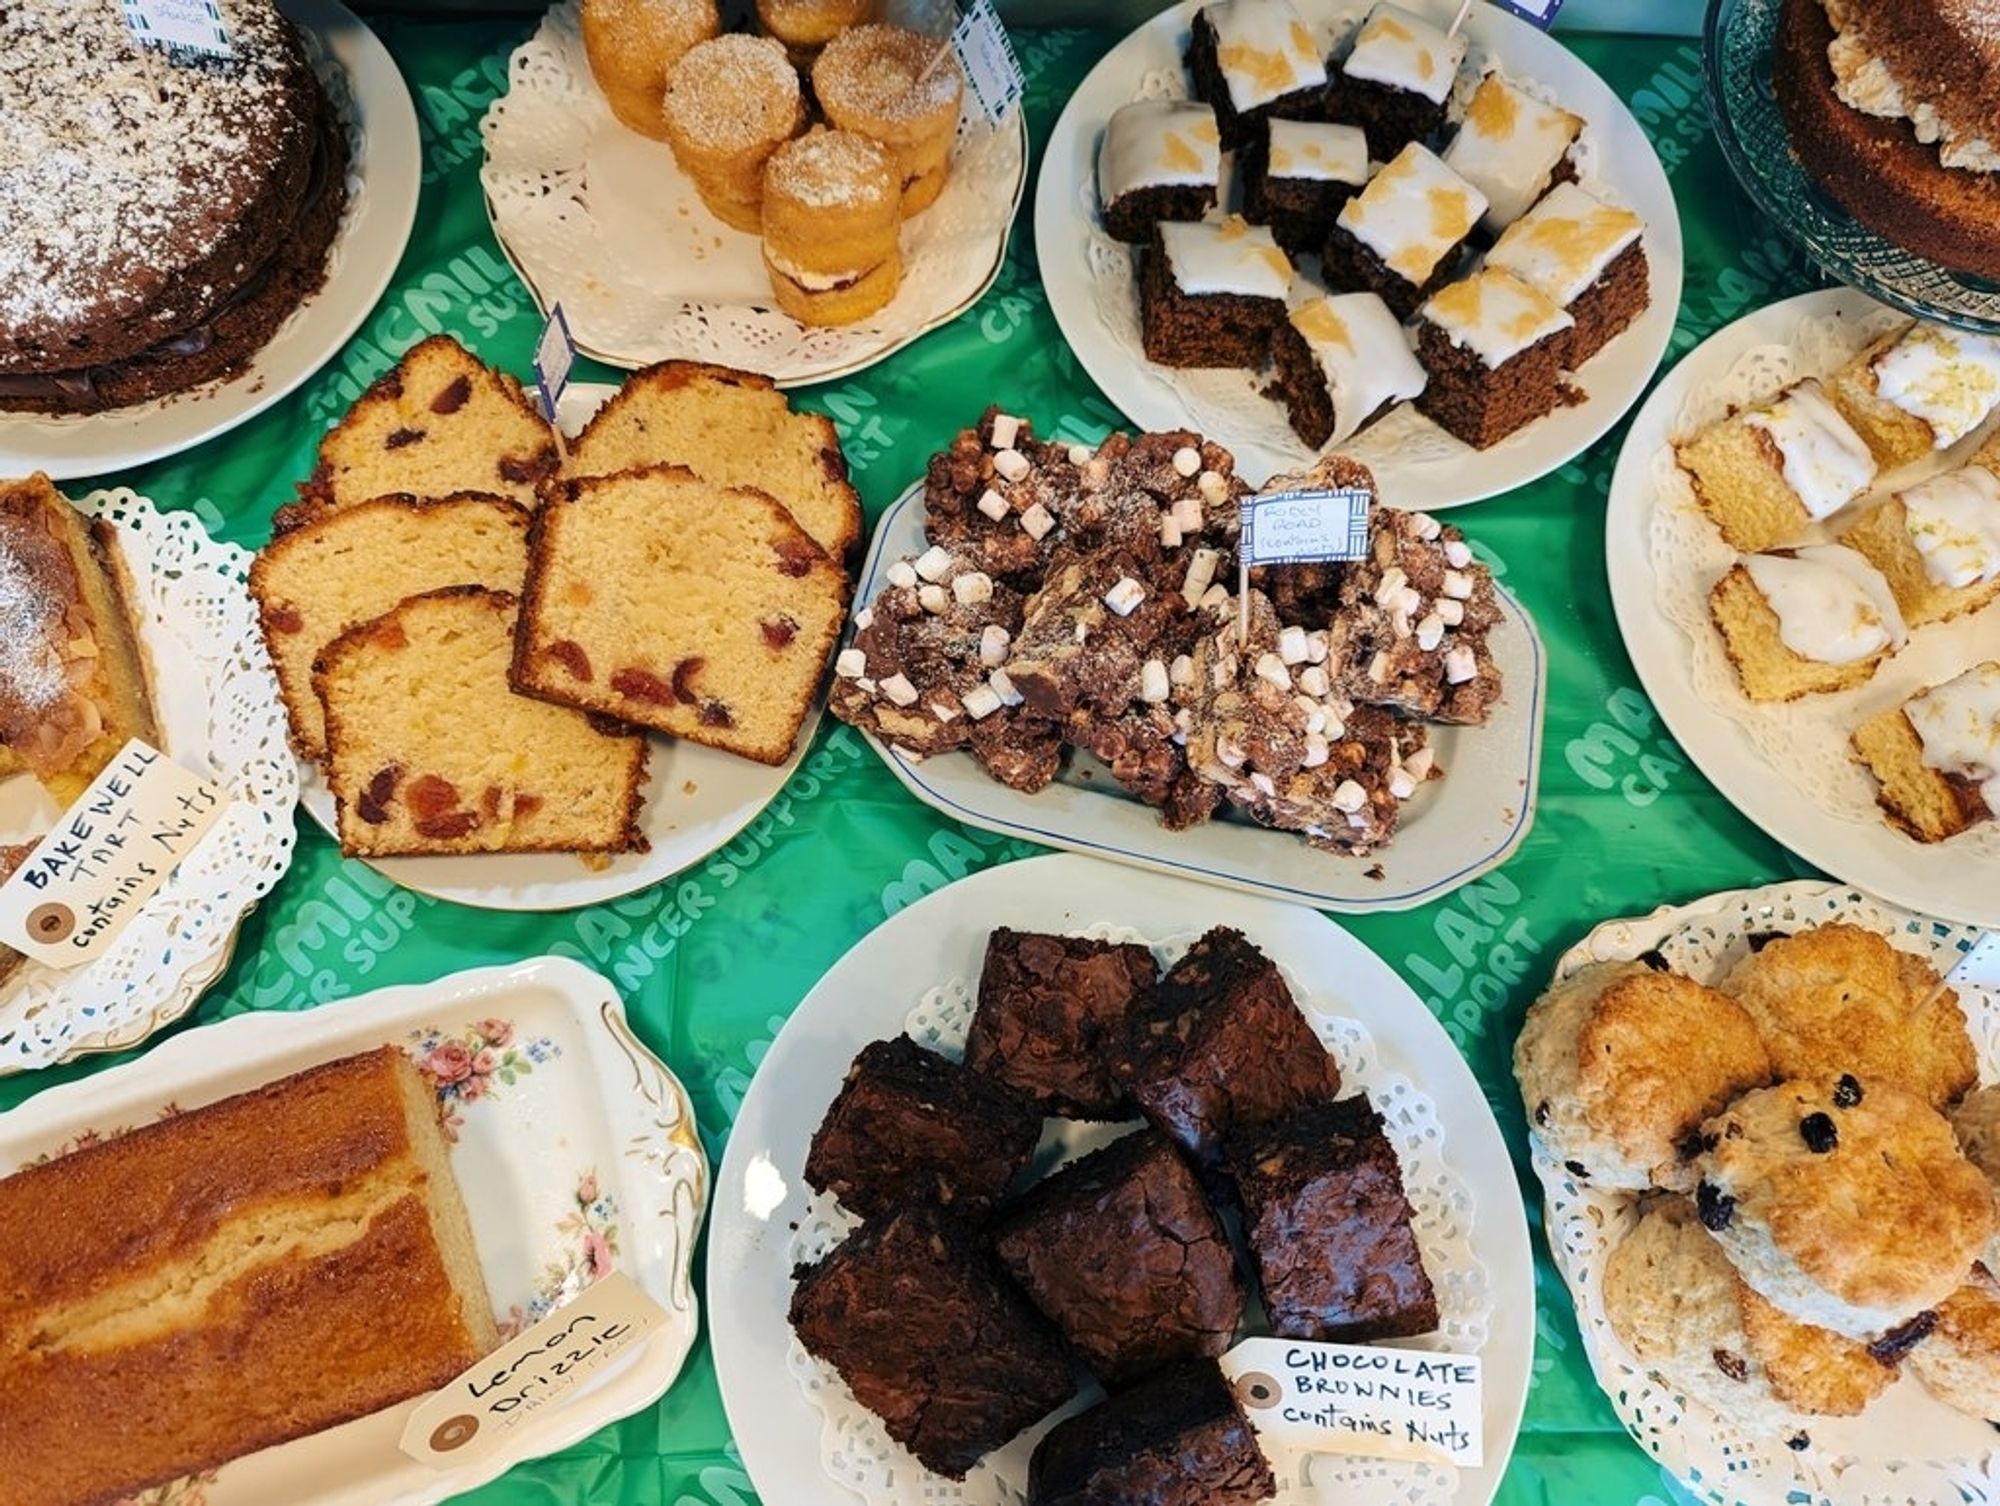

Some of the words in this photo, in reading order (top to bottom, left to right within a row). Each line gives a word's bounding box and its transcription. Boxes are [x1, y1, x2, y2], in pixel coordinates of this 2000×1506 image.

[23, 751, 158, 890] BAKEWELL
[69, 808, 142, 883] TART
[707, 726, 862, 889] SUPPORT
[613, 880, 717, 1000] NCER
[468, 1315, 597, 1399] Lemon
[1285, 1347, 1477, 1385] CHOCOLATE
[1295, 1375, 1453, 1411] BROWNIES
[1282, 1403, 1393, 1437] contains
[1405, 1420, 1470, 1451] Nuts
